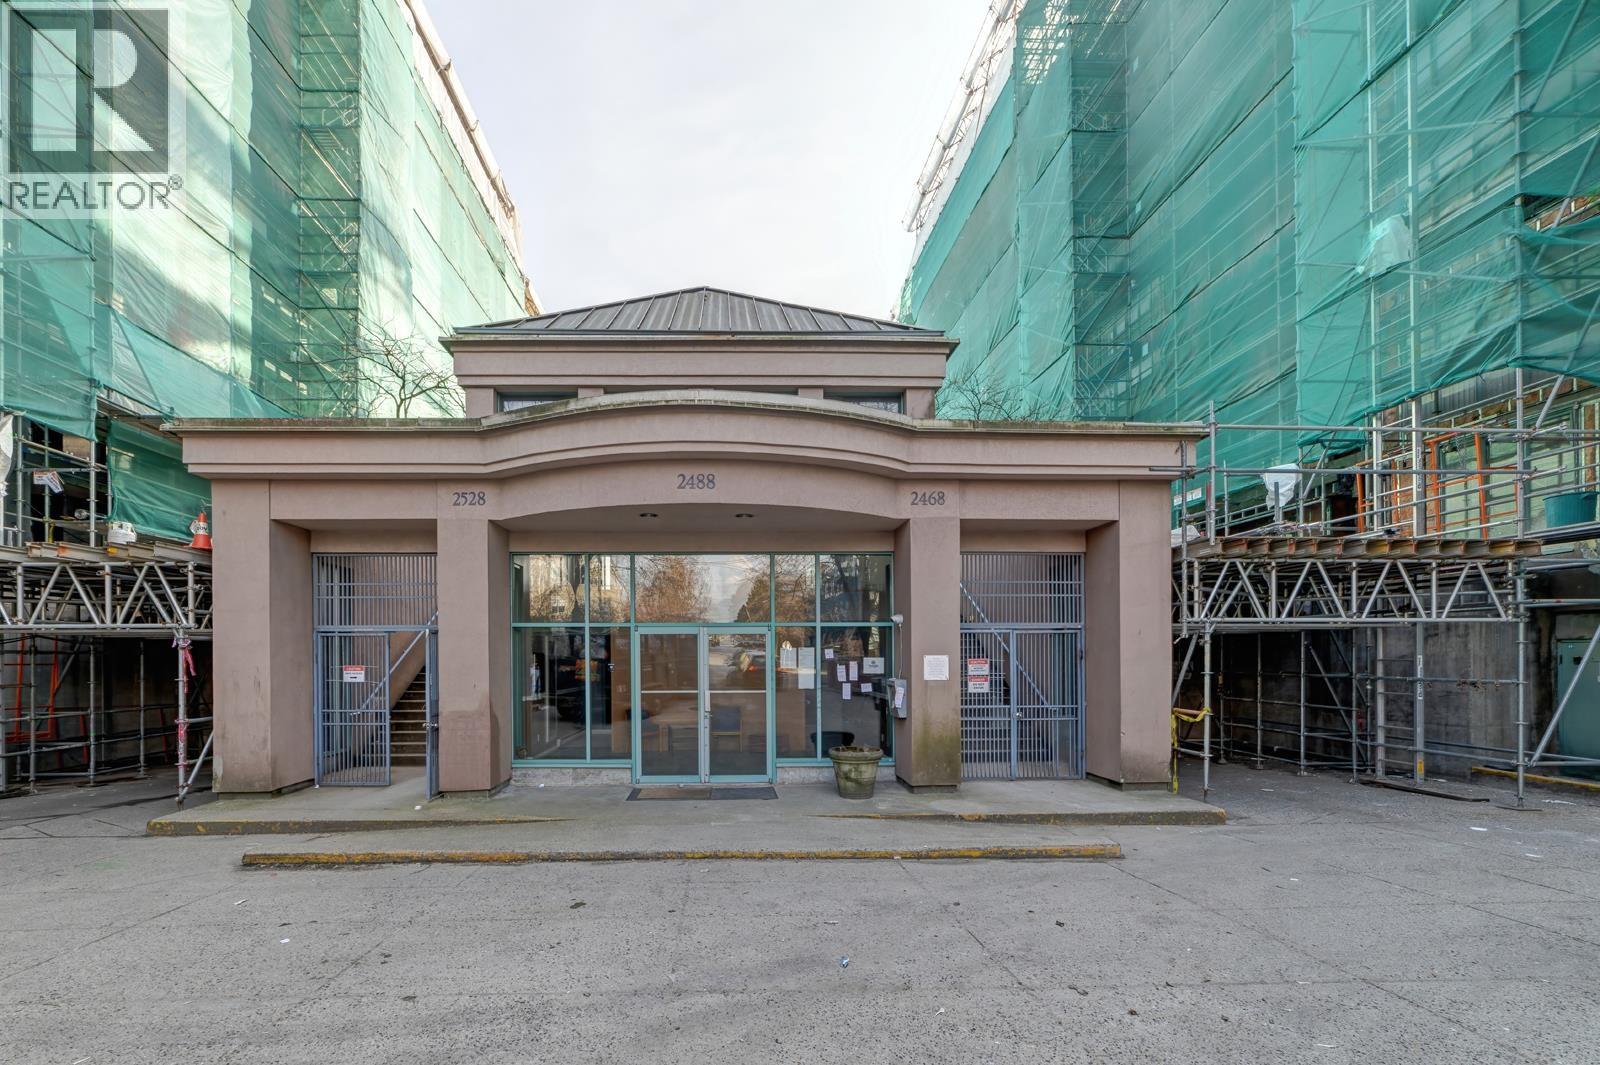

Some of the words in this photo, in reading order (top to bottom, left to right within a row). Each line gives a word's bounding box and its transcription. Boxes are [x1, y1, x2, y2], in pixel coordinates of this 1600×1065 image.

[677, 473, 716, 490] 2488
[452, 491, 486, 506] 2528
[911, 490, 945, 506] 2468
